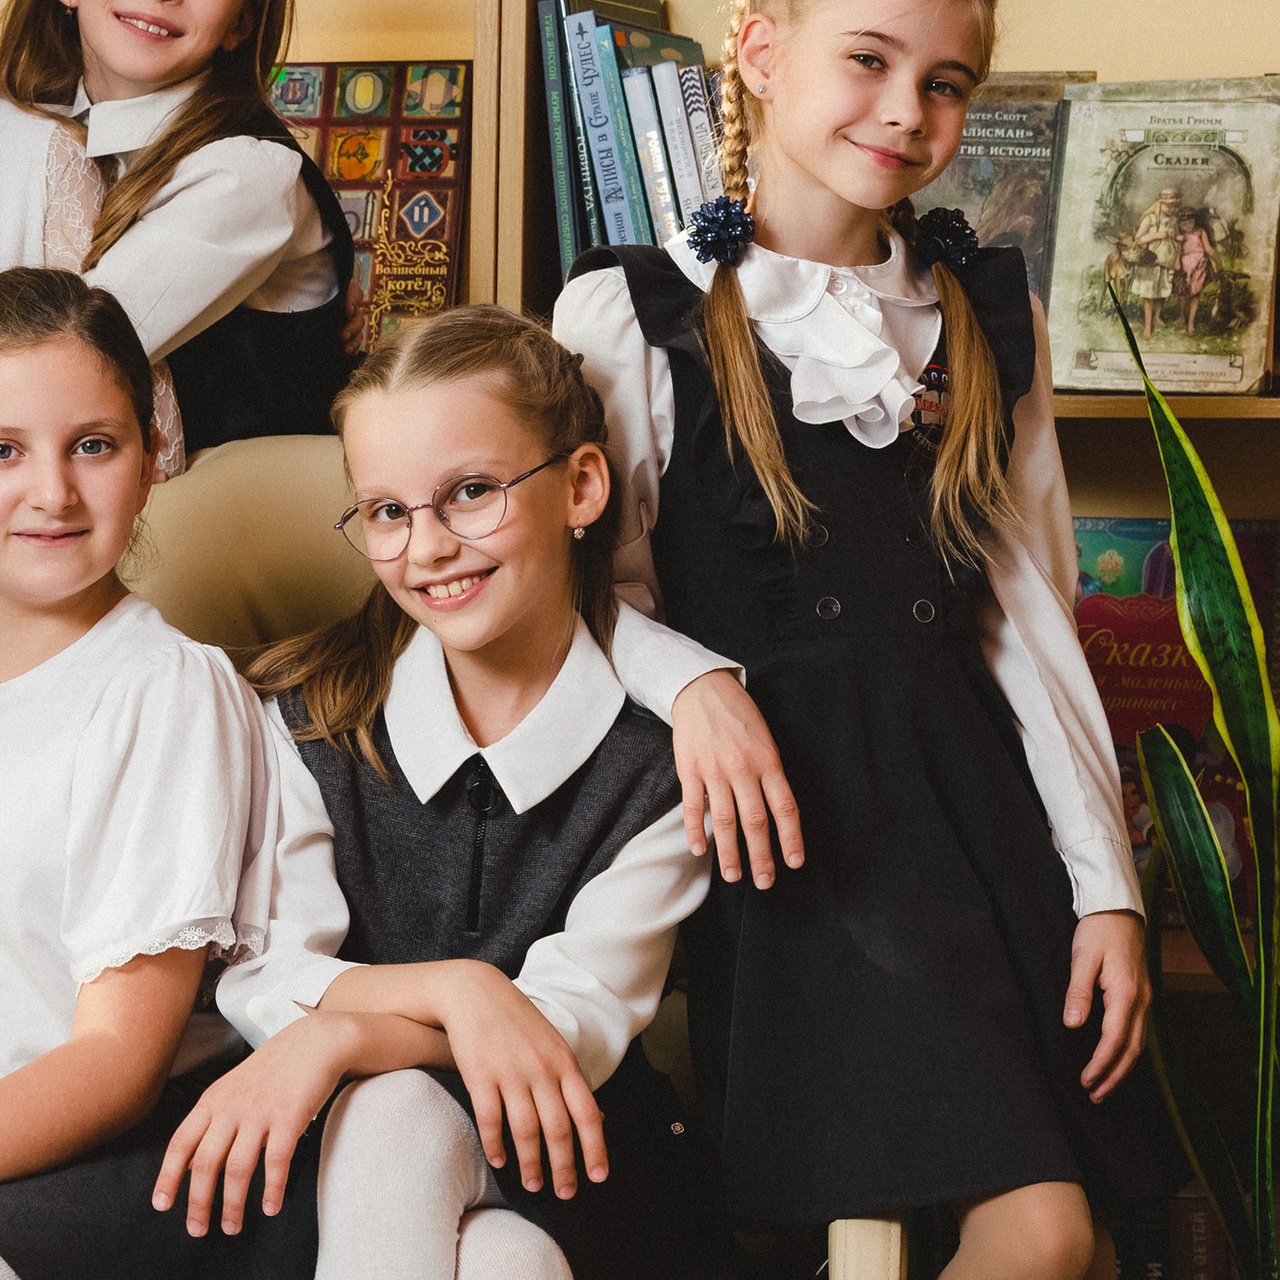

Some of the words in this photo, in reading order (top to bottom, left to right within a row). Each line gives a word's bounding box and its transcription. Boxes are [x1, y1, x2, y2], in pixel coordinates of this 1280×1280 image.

[542, 13, 554, 39] ТУВЕ
[544, 40, 558, 81] ЯНССОН
[548, 90, 566, 167] МУМИ-ТРОЛЛИ:
[576, 135, 591, 183] РОБИН
[989, 145, 1052, 158] ИСТОРИИ
[555, 170, 569, 212] ПОЛНОЕ
[582, 185, 595, 211] ГУД
[645, 129, 664, 173] РОБИН
[660, 212, 679, 243] КОР
[1083, 628, 1192, 668] Сказк
[1117, 676, 1204, 691] маленьки
[1187, 1209, 1211, 1267] ДЕТЕЙ
